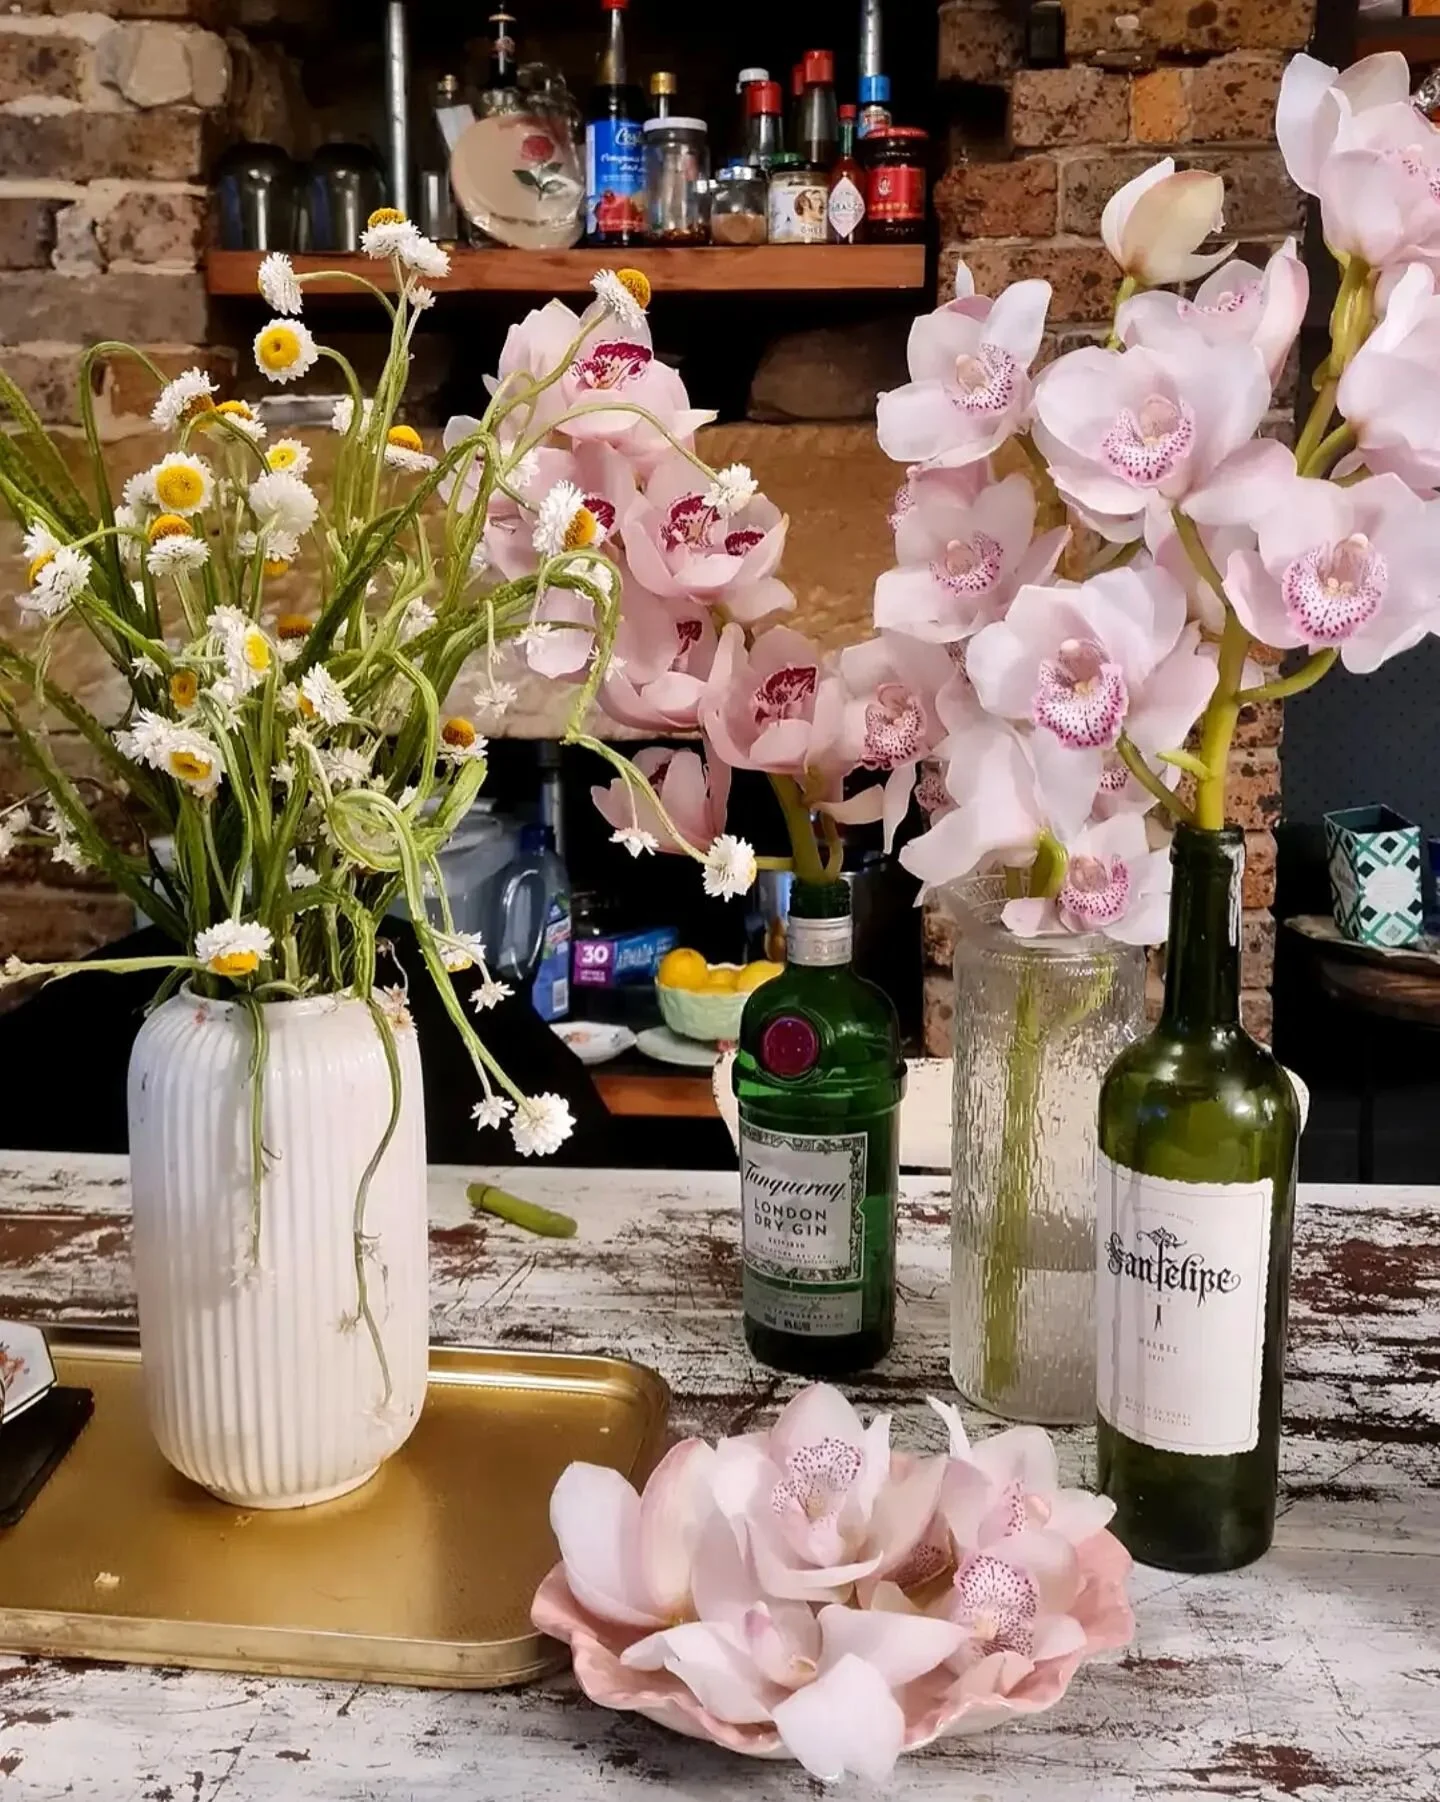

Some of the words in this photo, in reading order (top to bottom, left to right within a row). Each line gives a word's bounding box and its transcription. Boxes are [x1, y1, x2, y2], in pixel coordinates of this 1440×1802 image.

[582, 945, 609, 964] 30
[745, 1160, 846, 1203] Tanqueray
[754, 1197, 827, 1221] LONDON
[754, 1213, 784, 1232] DRY
[792, 1223, 827, 1236] GIN
